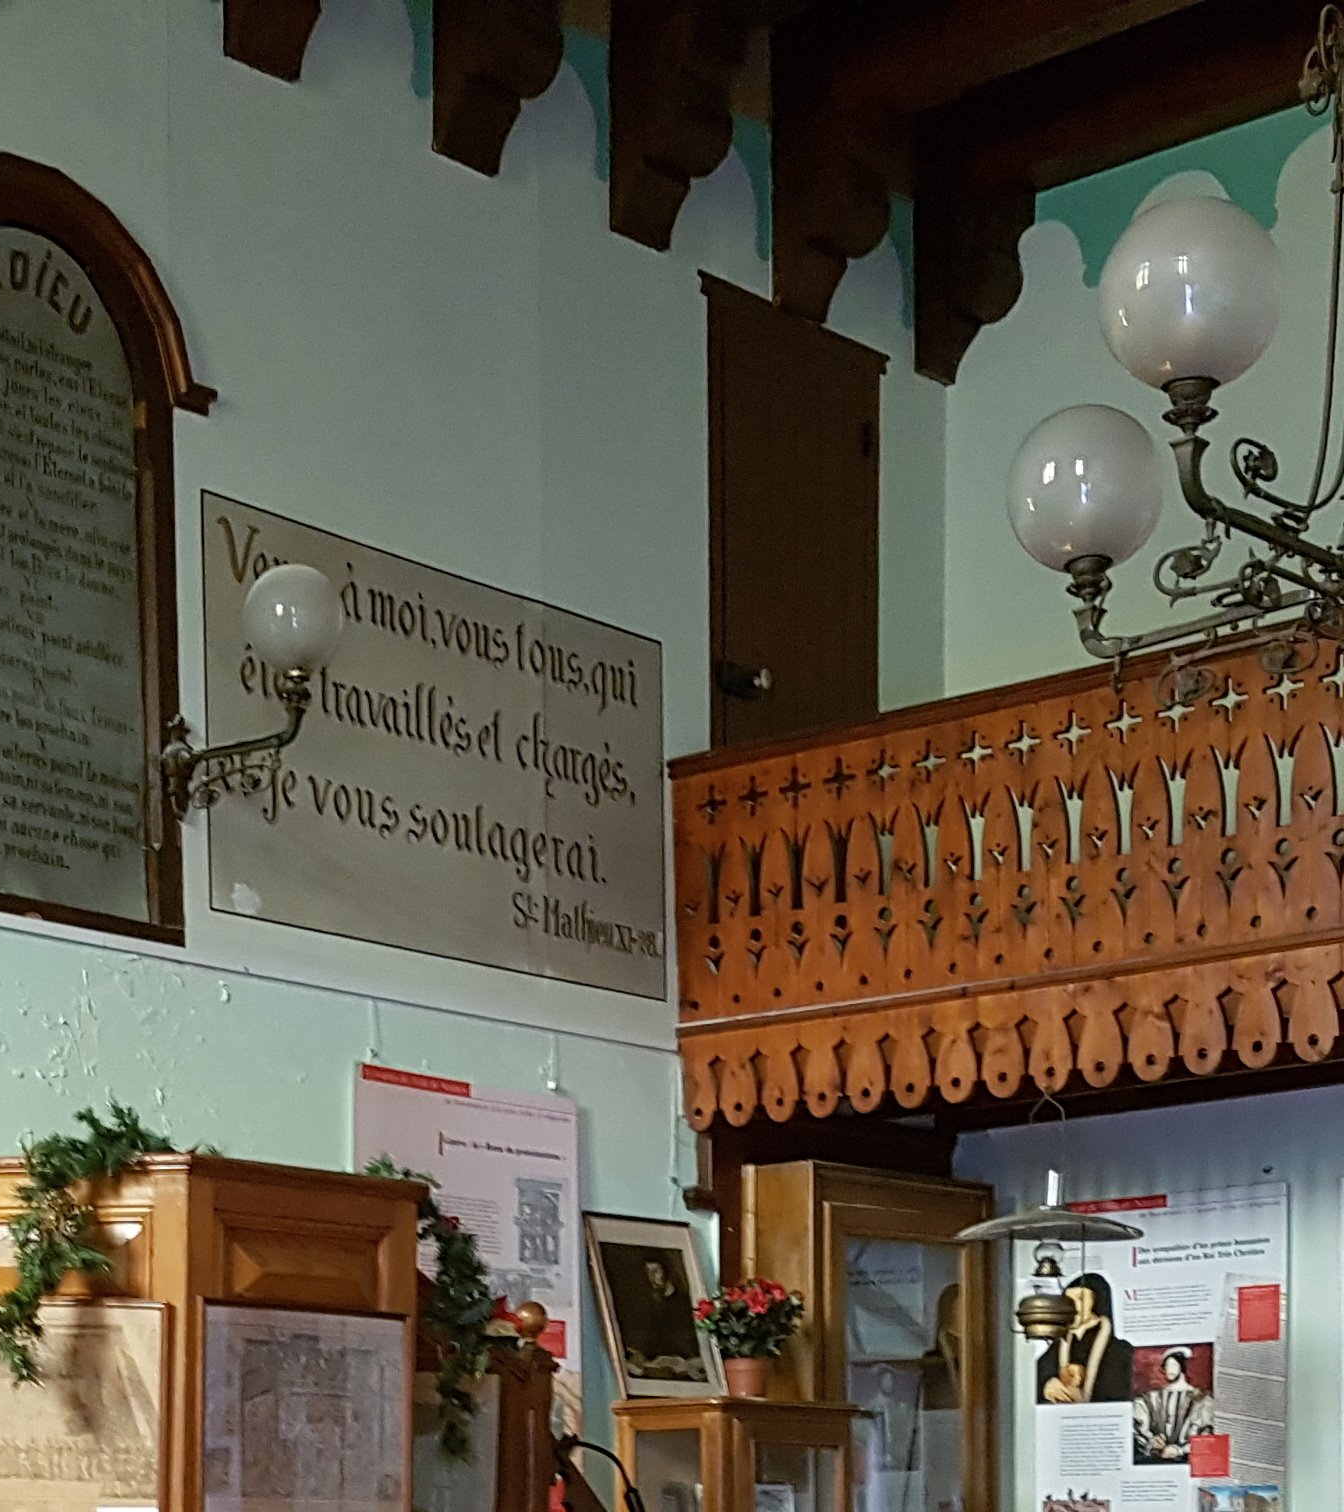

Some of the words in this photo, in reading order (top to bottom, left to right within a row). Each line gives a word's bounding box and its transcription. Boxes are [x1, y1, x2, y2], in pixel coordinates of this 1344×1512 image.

[434, 608, 511, 669] vous
[590, 660, 639, 715] qui
[320, 666, 472, 758] travaillés
[477, 709, 503, 763] et
[516, 712, 637, 807] chargés,
[308, 774, 401, 840] vous
[406, 805, 608, 885] soulagerai.
